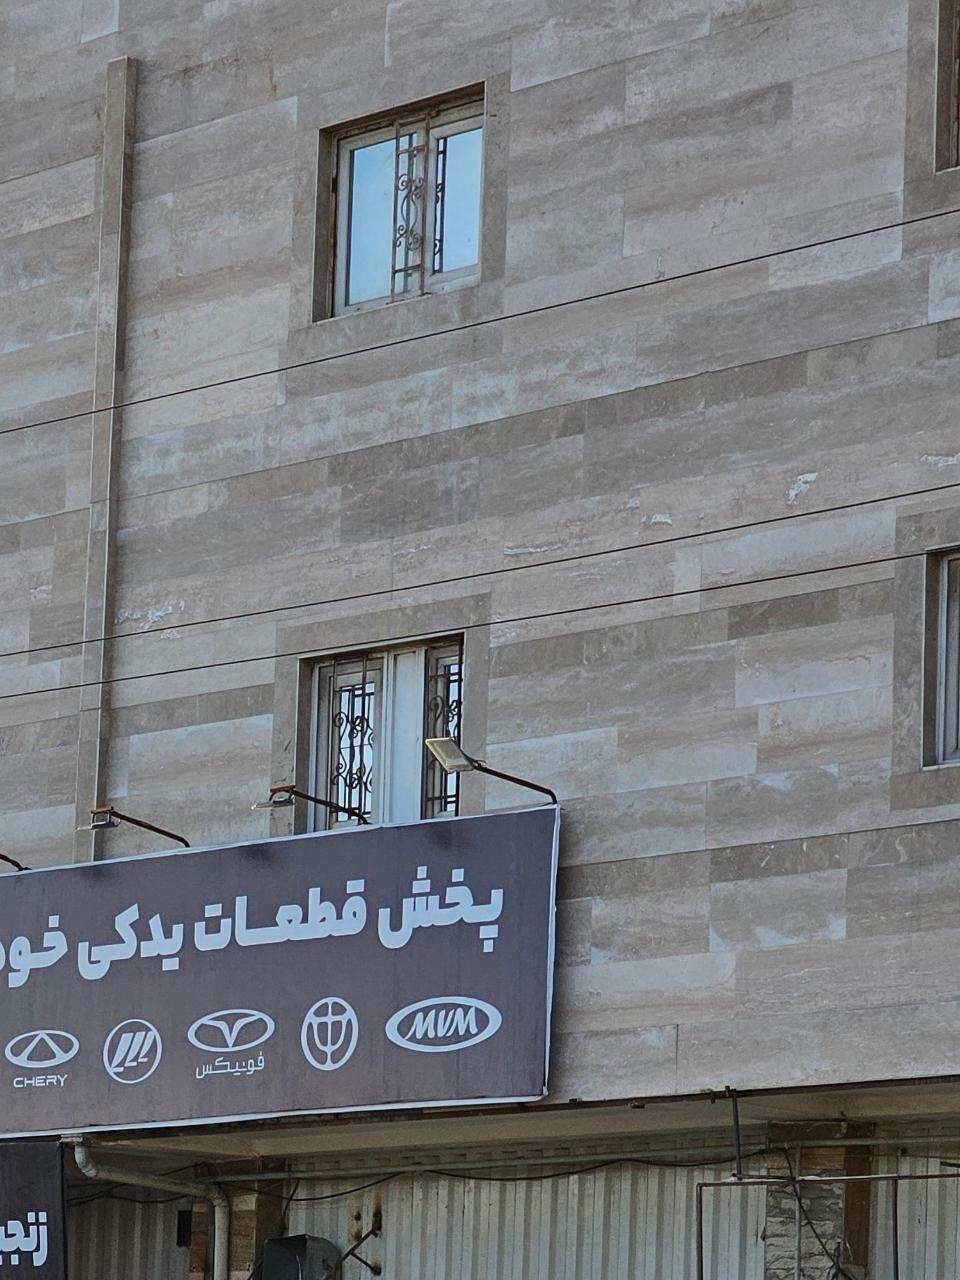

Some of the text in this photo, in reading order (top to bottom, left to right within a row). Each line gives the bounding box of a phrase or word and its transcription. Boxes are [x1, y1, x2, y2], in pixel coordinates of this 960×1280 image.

[194, 879, 367, 951] قطعات
[378, 865, 504, 952] پخش
[77, 903, 184, 981] یدکی
[404, 1006, 479, 1040] MVM
[13, 1074, 69, 1088] CHERY
[195, 1051, 265, 1079] فونیکس
